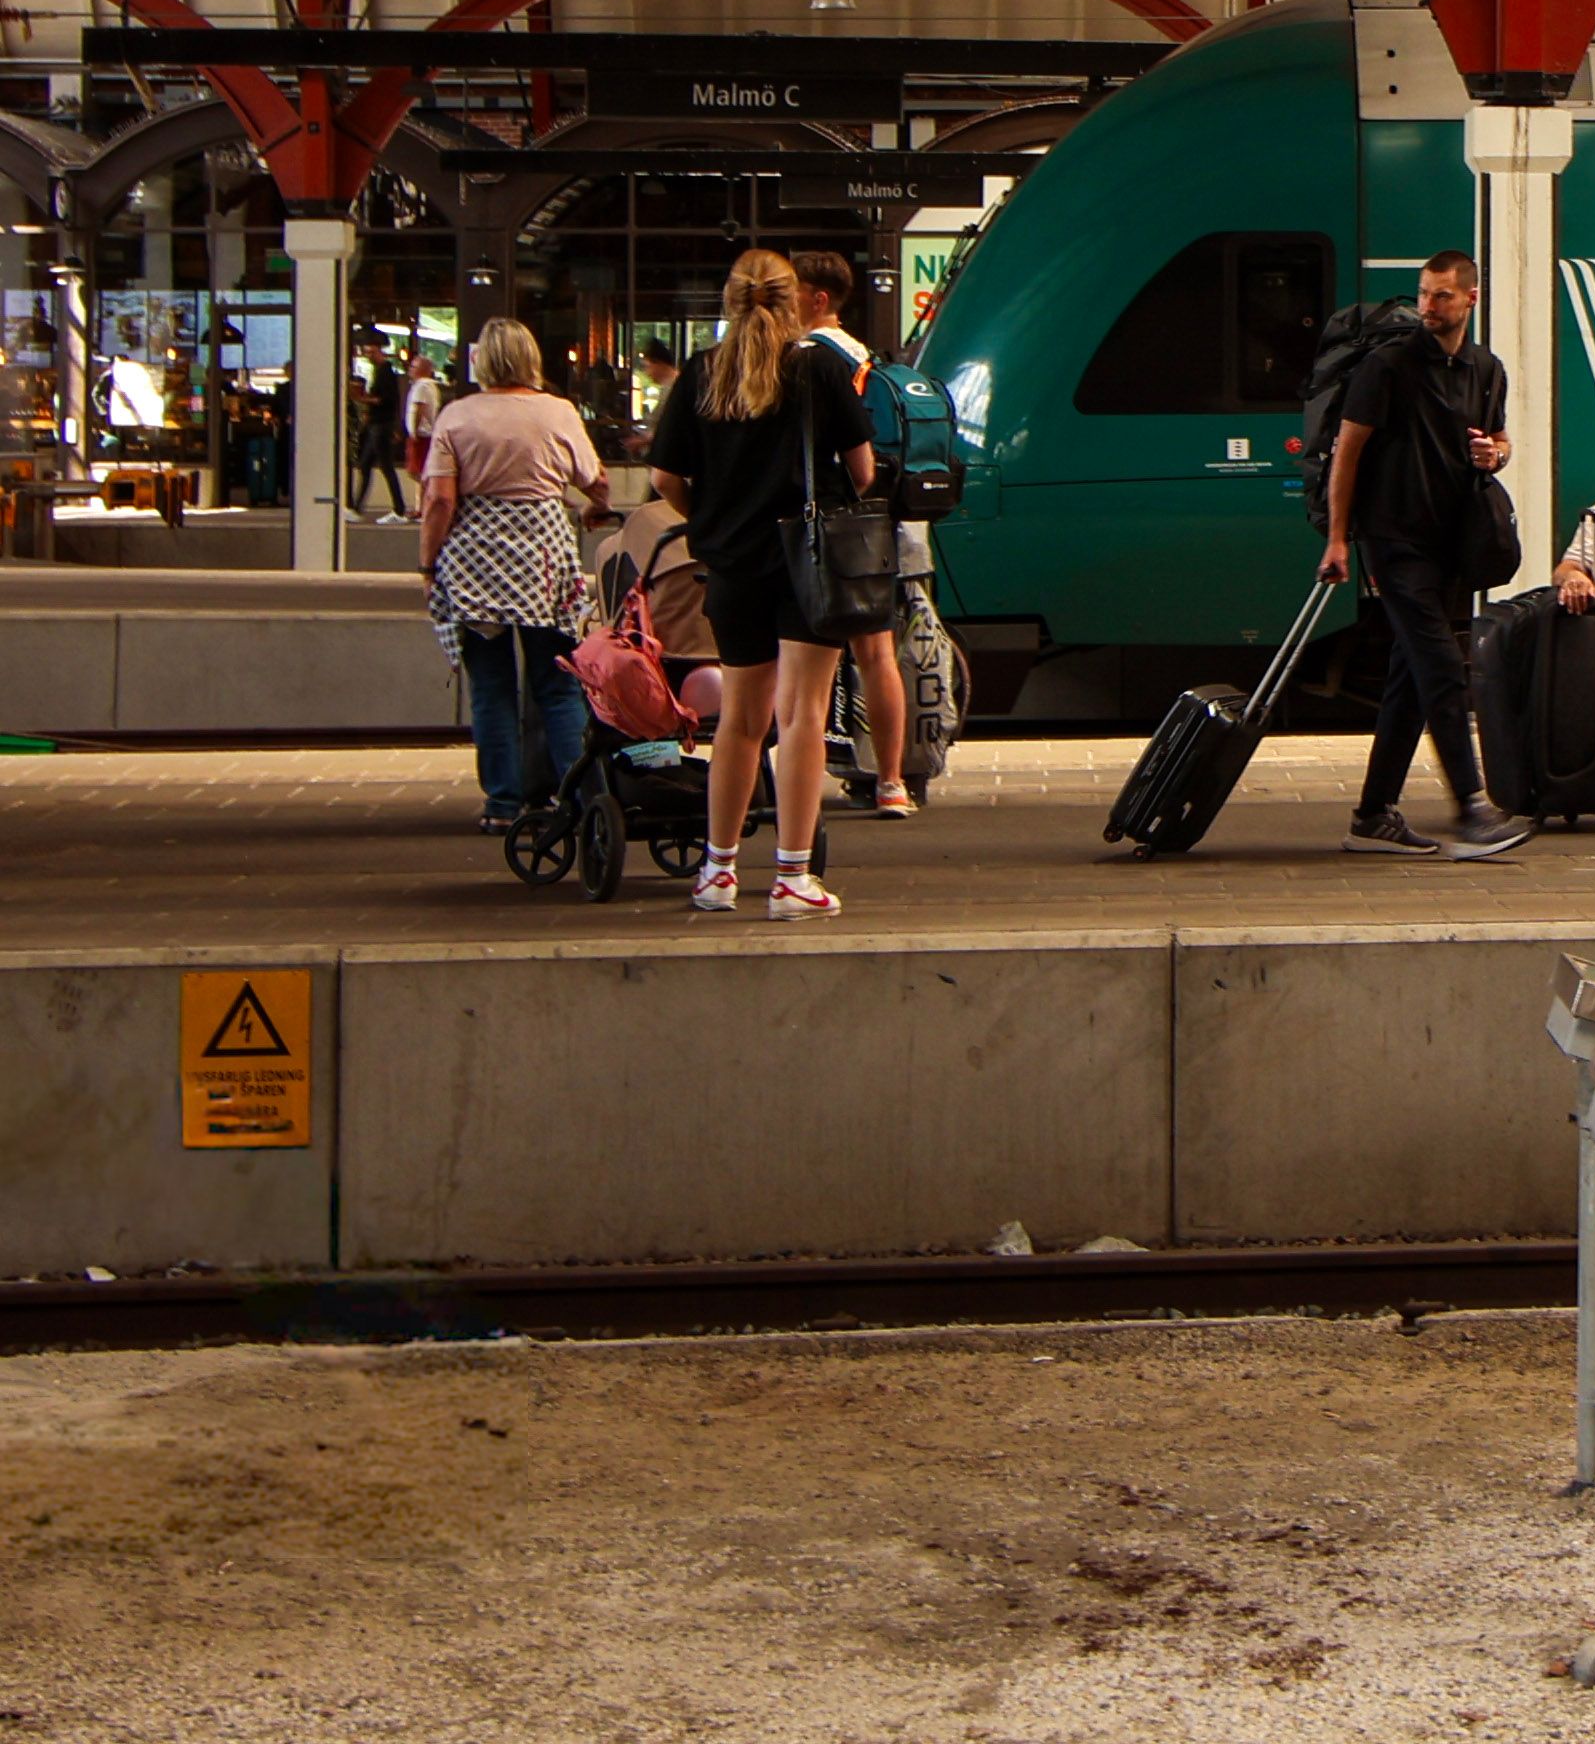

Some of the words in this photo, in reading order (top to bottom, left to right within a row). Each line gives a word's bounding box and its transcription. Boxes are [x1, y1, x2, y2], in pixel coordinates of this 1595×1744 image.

[693, 83, 776, 107] Malmö
[784, 85, 800, 107] C
[848, 182, 903, 198] Malmö
[906, 183, 919, 199] C
